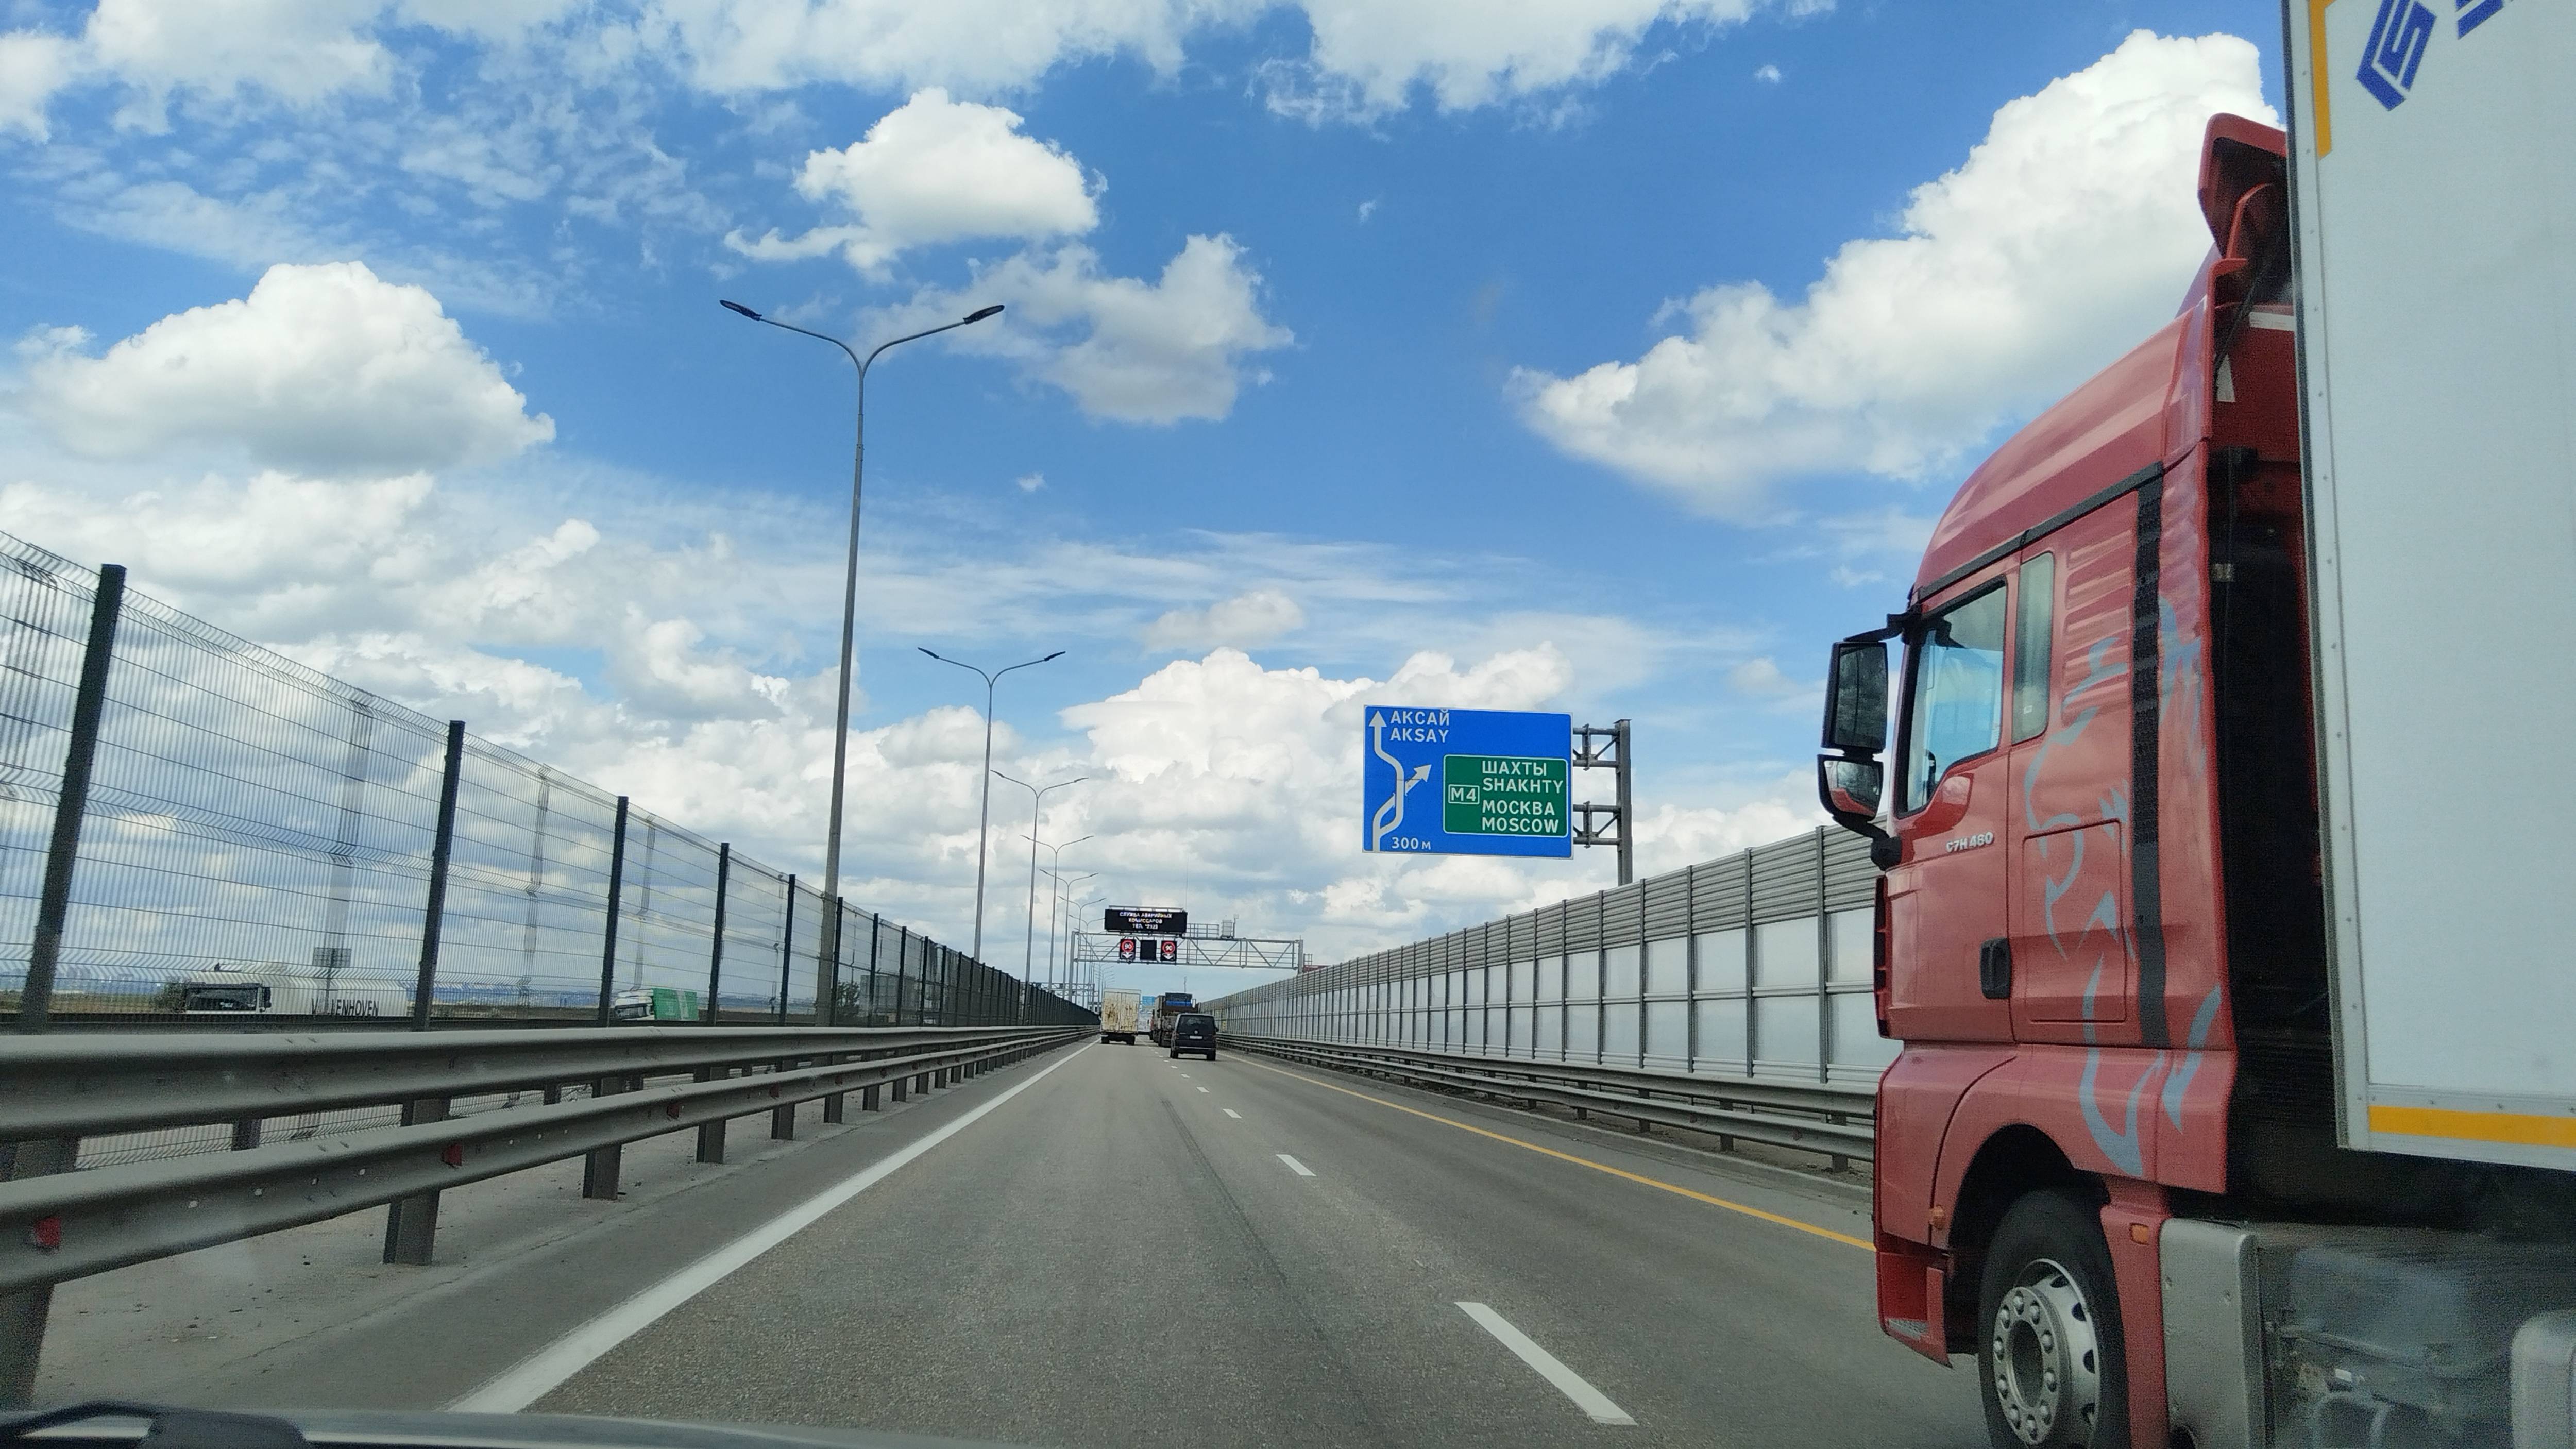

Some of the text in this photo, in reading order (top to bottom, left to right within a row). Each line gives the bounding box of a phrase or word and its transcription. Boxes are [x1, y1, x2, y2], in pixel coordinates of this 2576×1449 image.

[1391, 709, 1449, 726] АКСАЙ
[1390, 728, 1449, 743] AKSAY
[1482, 761, 1546, 776] ШАХТЫ
[1483, 778, 1563, 794] SHAKHTY
[1482, 800, 1555, 815] МОСКВА
[1482, 817, 1558, 833] MOSCOW
[1392, 837, 1418, 849] 300
[1969, 832, 1994, 848] 480
